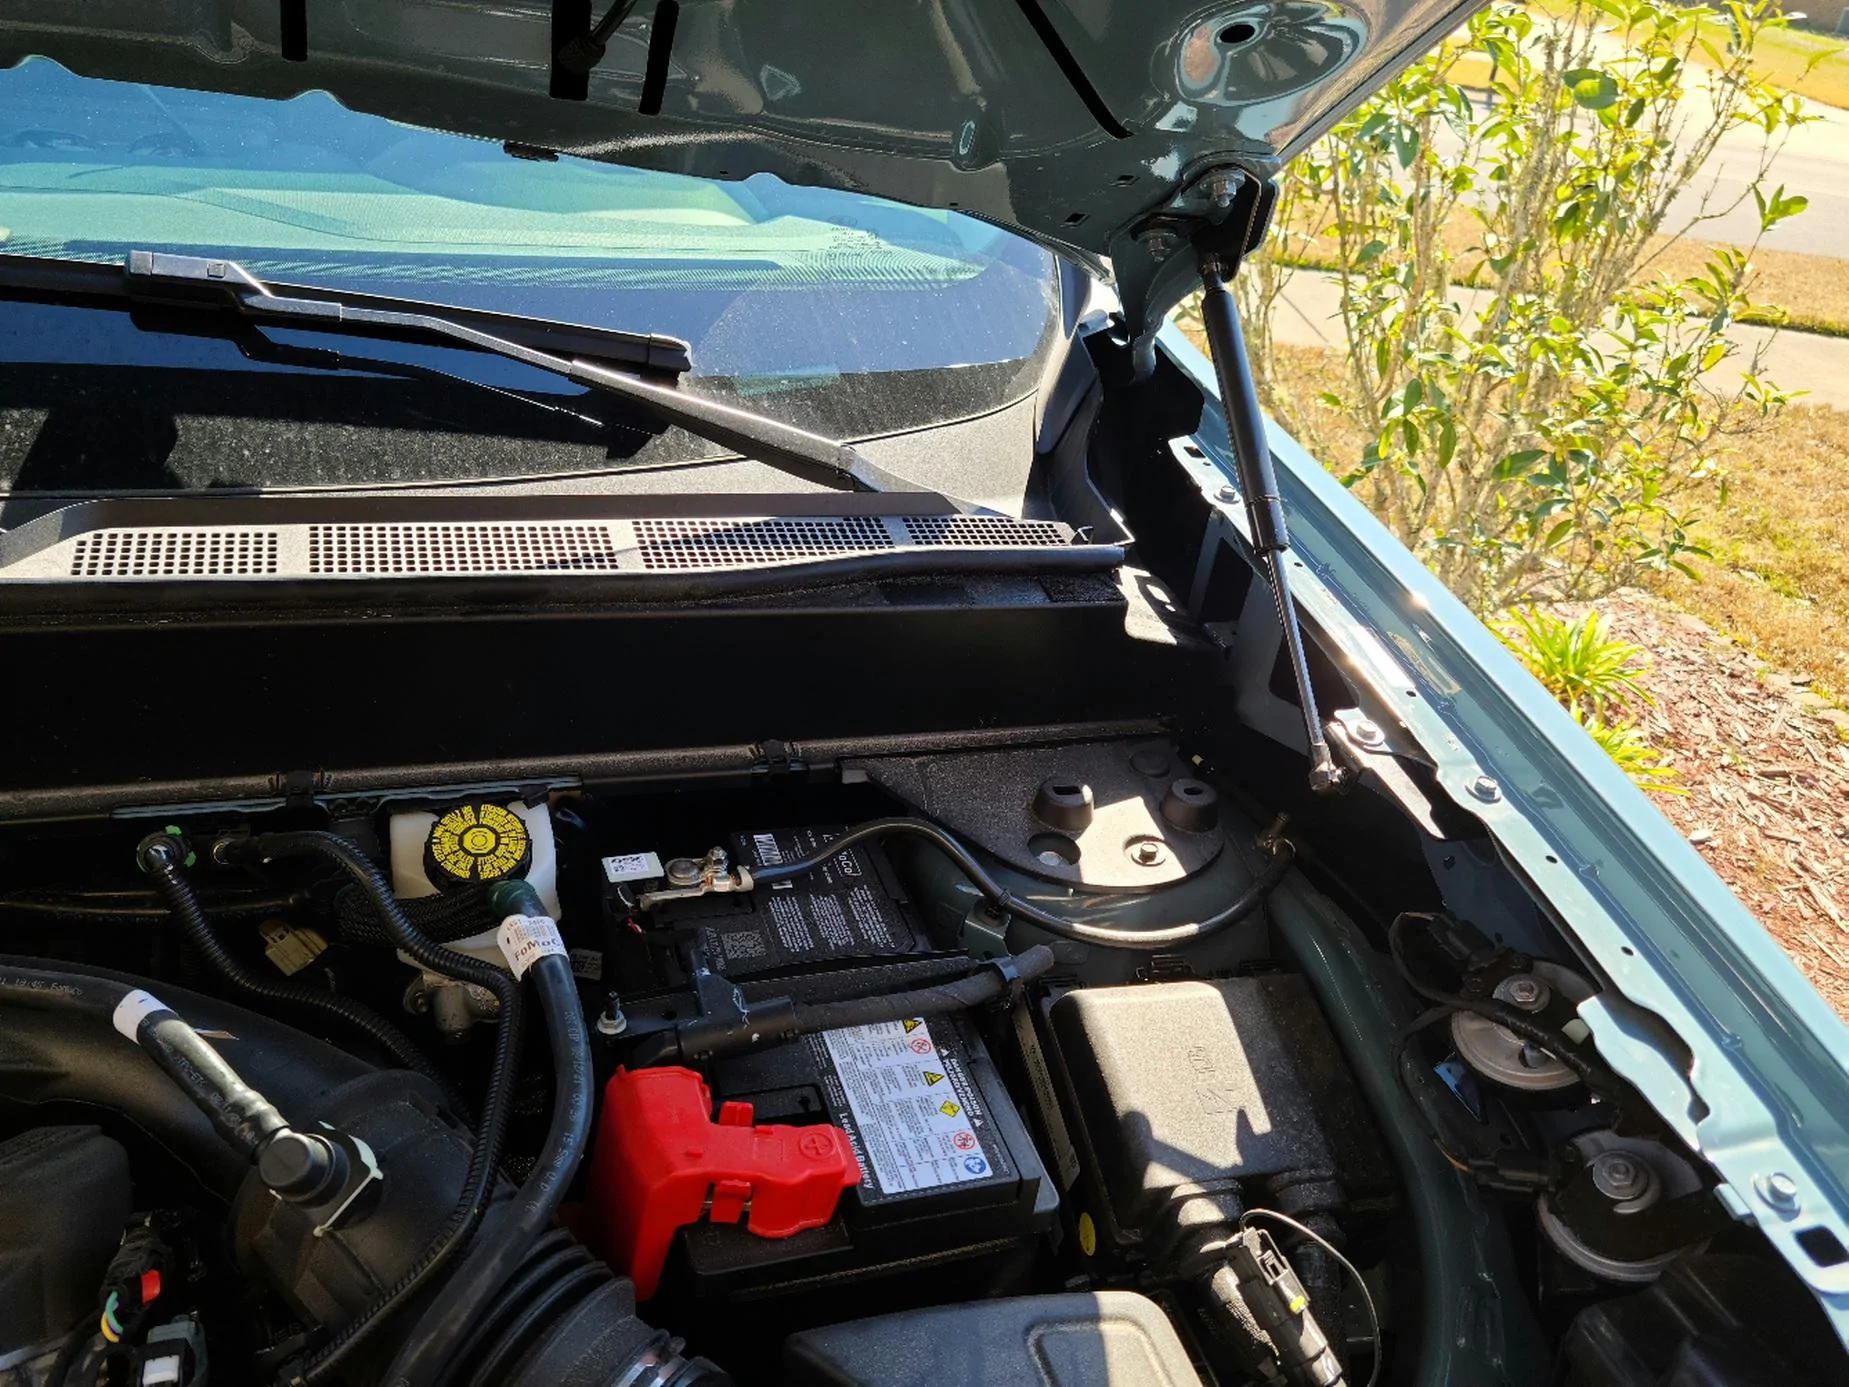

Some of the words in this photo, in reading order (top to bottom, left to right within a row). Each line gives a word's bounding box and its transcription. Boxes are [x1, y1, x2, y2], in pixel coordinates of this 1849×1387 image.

[839, 1112, 855, 1135] Lead
[848, 1134, 863, 1156] Acid
[856, 1155, 875, 1190] Battery
